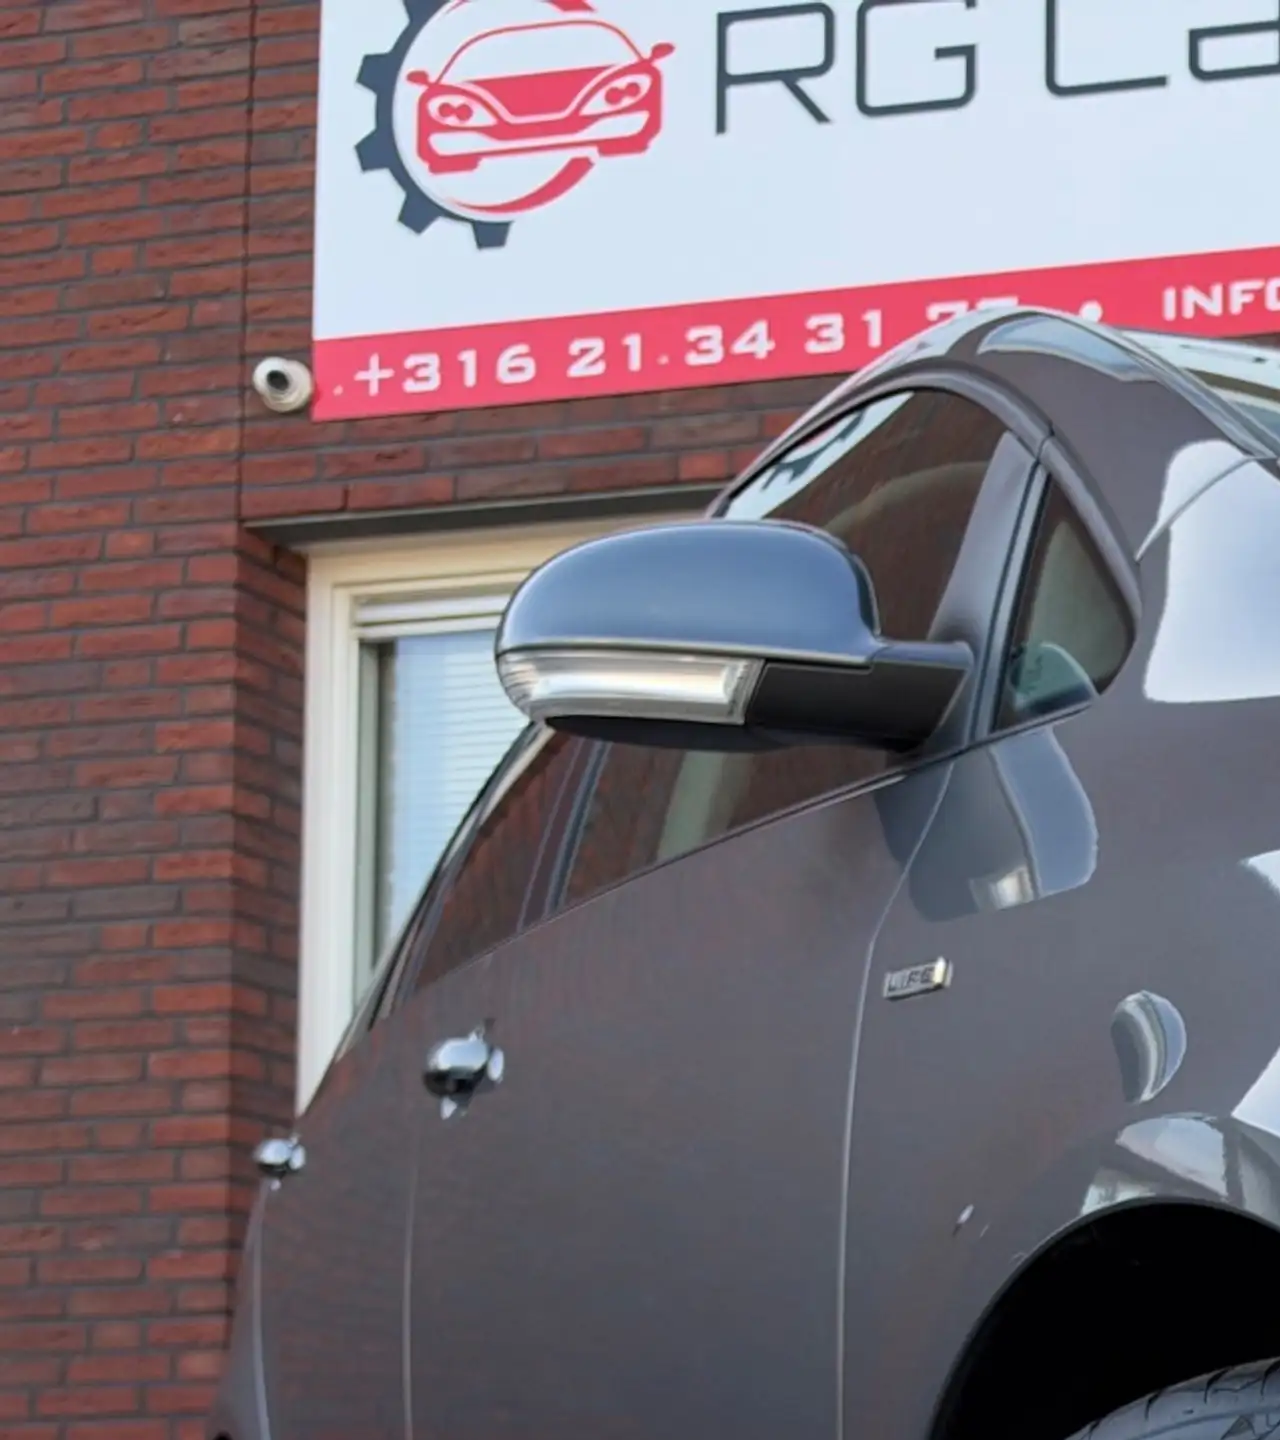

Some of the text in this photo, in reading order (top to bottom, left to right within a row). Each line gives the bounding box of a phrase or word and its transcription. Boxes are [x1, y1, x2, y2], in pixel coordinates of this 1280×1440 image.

[716, 0, 977, 135] RG
[354, 343, 536, 396] +316
[804, 308, 882, 354] 31
